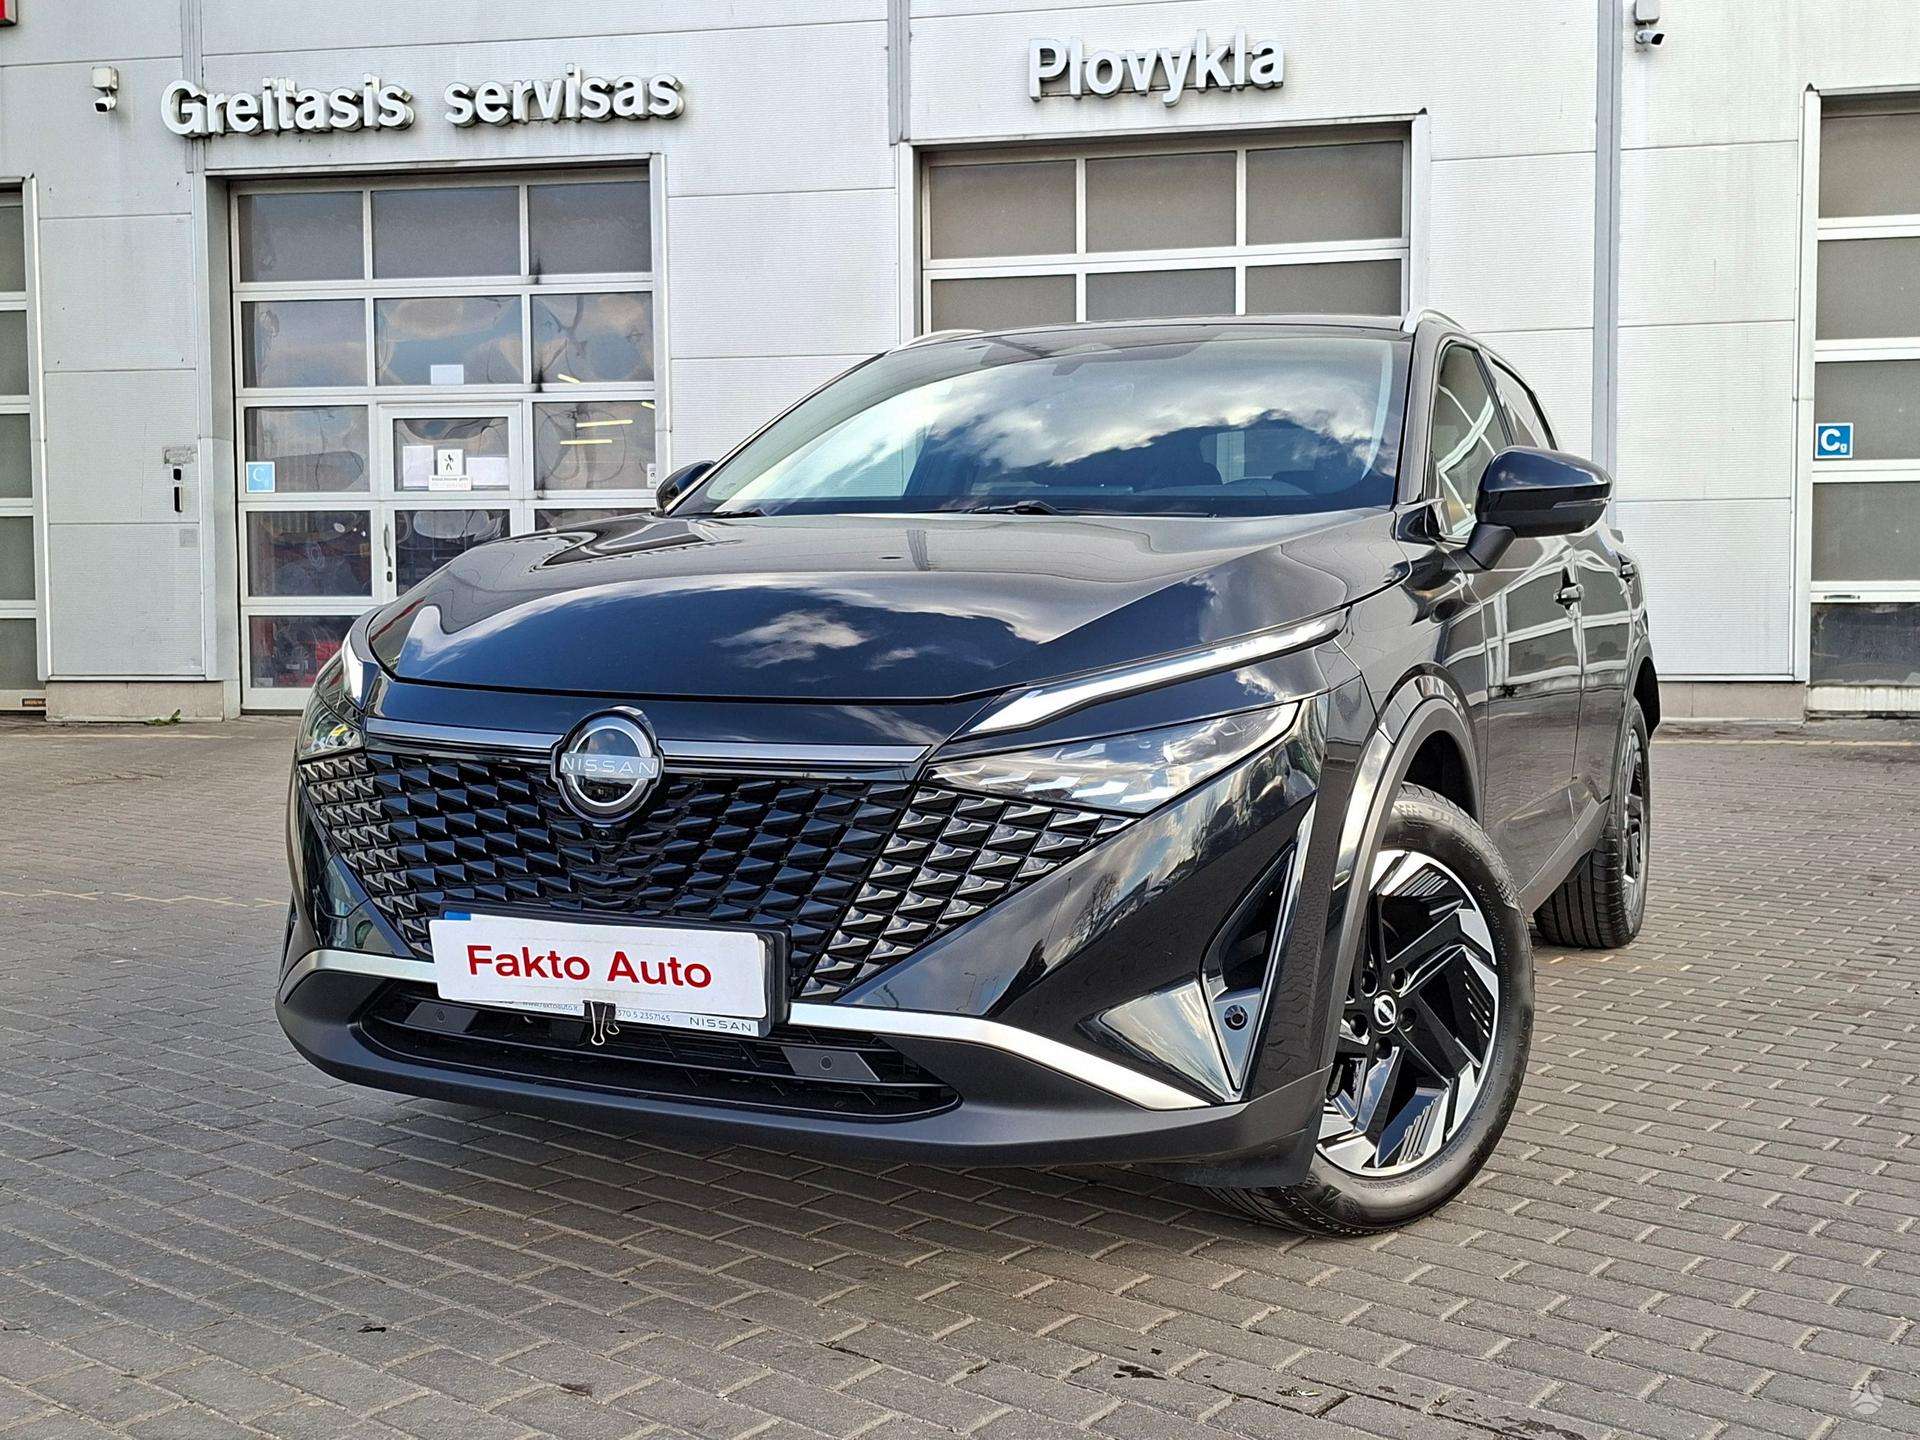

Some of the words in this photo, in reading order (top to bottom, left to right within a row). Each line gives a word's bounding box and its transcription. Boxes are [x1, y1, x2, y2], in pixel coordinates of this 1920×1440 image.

[1028, 27, 1283, 107] Plovykla
[161, 73, 414, 137] Greitasis
[443, 63, 684, 128] servisas
[562, 757, 655, 775] NISSAN
[467, 945, 590, 981] Fakto
[607, 951, 711, 988] Auto
[689, 1016, 752, 1032] NISSAN
